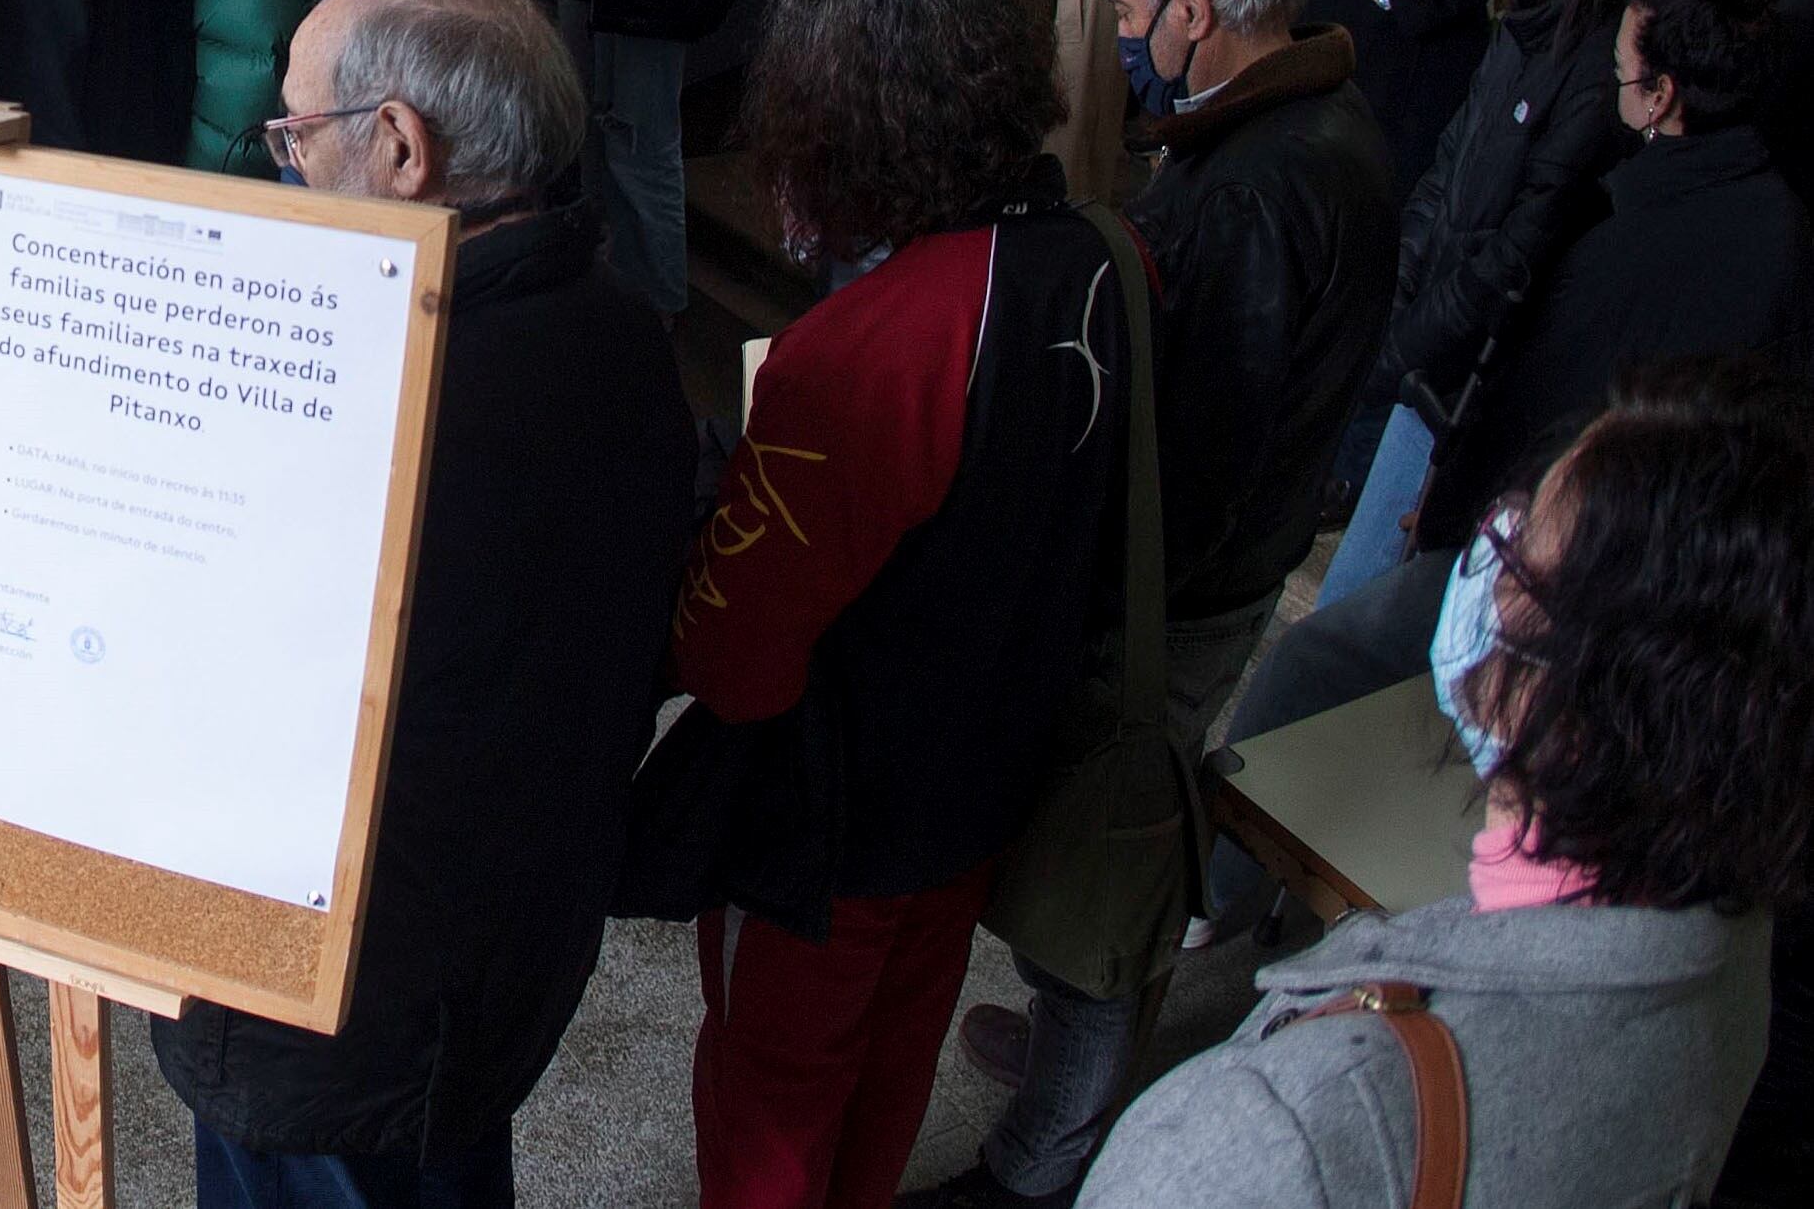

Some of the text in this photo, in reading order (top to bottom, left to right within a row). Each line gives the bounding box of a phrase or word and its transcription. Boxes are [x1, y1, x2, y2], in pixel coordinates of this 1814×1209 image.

[10, 266, 334, 347] familias que perderon aos
[12, 233, 338, 310] Concentración en apoio ás
[1, 306, 337, 385] seus familiares na traxedia
[33, 344, 190, 393] afundimento
[198, 376, 228, 401] do
[237, 383, 294, 414] Villa
[302, 397, 333, 422] de
[59, 487, 74, 499] Na
[77, 494, 108, 509] porta
[111, 500, 126, 512] de
[129, 505, 174, 523] entrada
[177, 514, 192, 527] do
[92, 464, 107, 474] no
[142, 474, 157, 486] do
[83, 526, 97, 537] un
[100, 531, 141, 550] minuto
[144, 540, 158, 552] de
